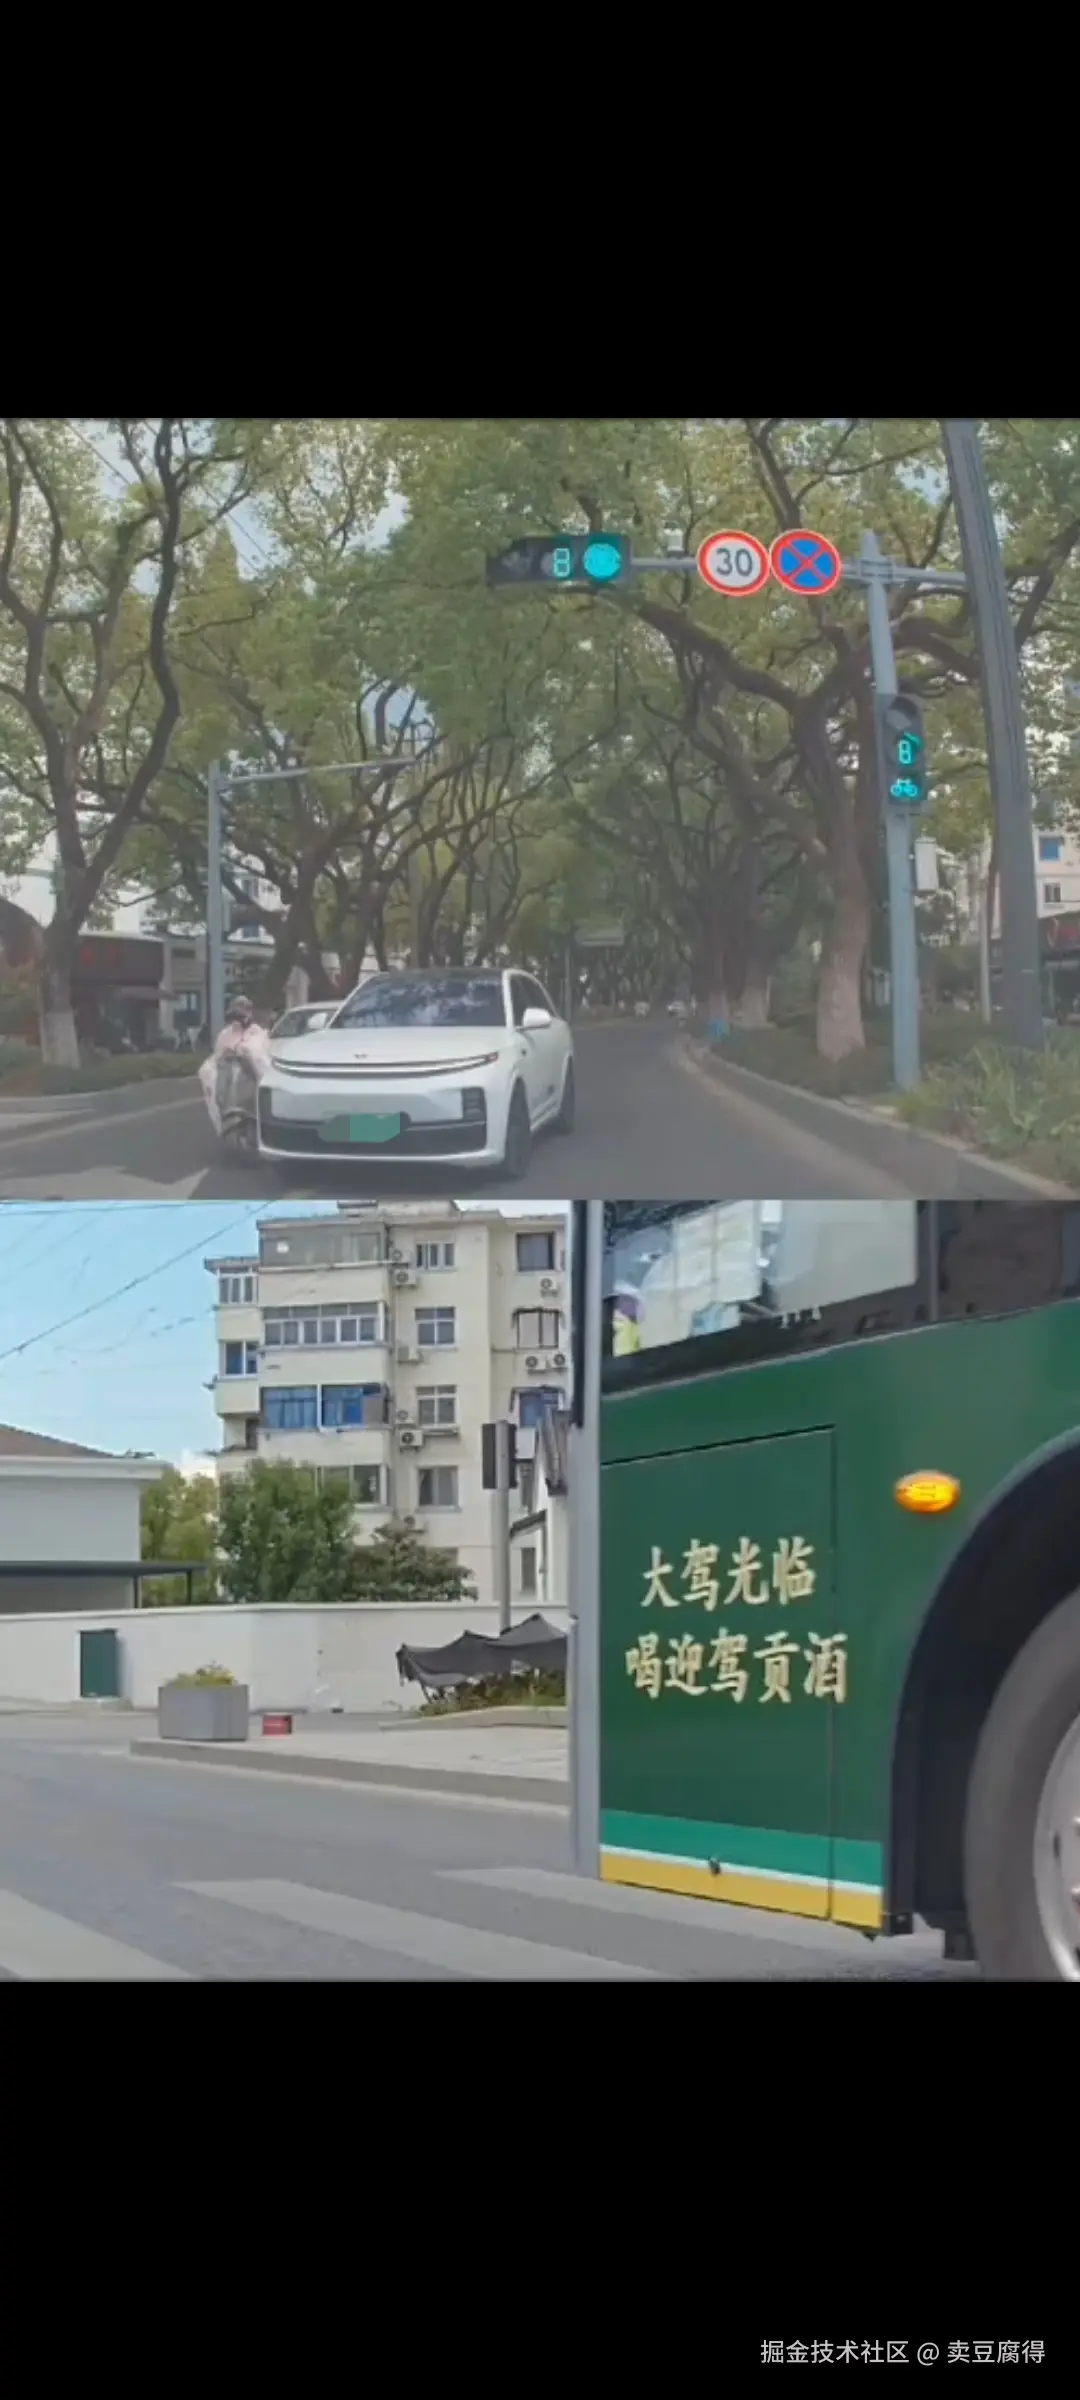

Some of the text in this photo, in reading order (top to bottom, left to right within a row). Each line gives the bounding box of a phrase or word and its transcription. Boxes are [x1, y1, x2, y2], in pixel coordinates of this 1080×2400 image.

[715, 547, 753, 578] 30
[640, 1535, 817, 1612] 大驾光临
[624, 1626, 849, 1704] 喝迎驾贡酒
